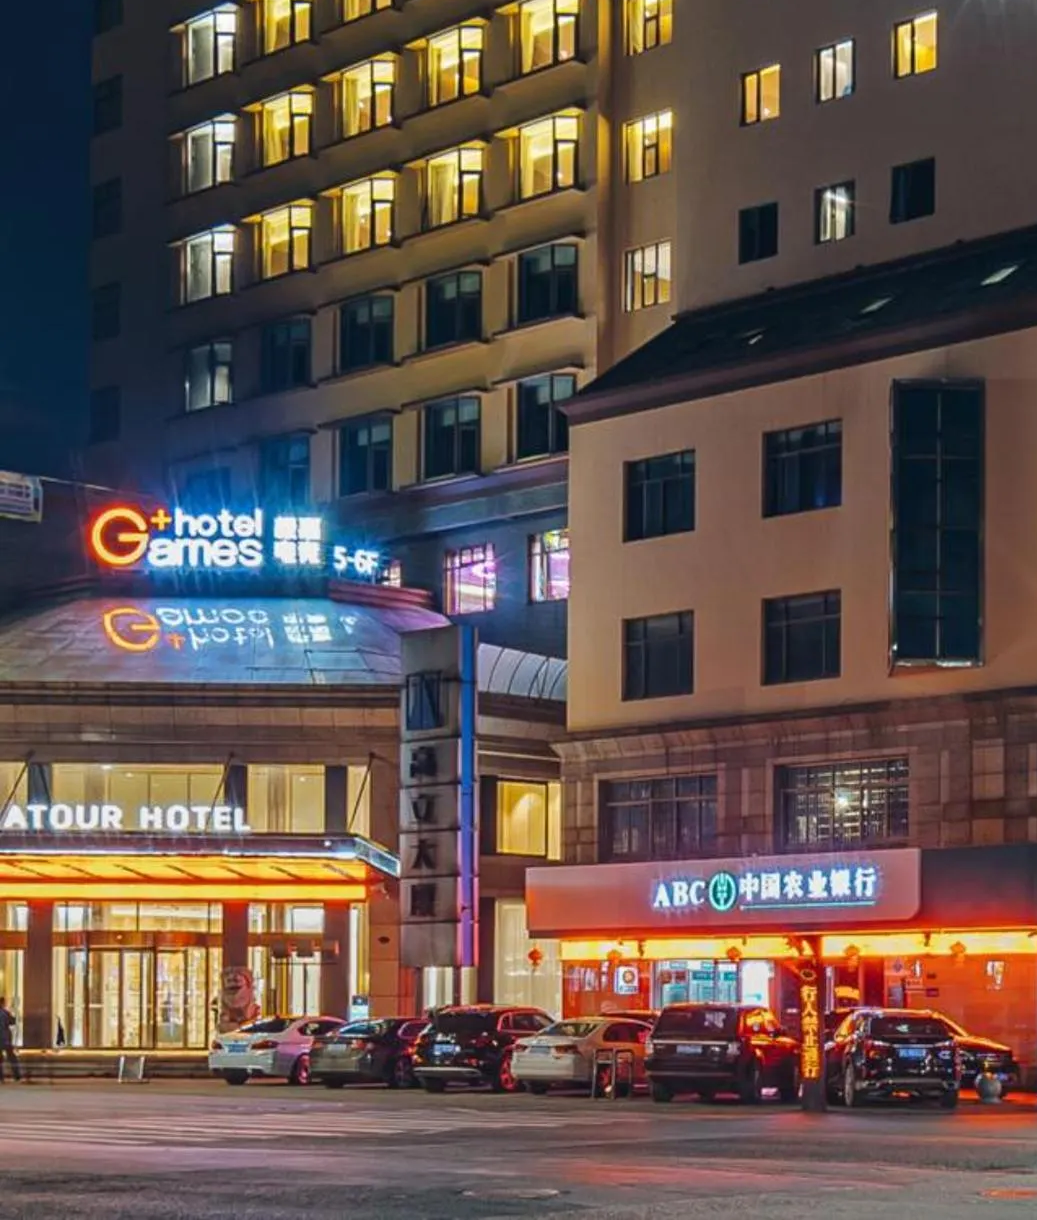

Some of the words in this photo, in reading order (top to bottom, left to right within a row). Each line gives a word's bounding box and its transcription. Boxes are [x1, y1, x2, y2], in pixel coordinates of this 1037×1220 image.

[333, 546, 379, 575] 5-6F
[3, 803, 124, 830] ATOUR
[139, 804, 251, 832] HOTEL
[653, 881, 706, 908] ABC
[738, 867, 877, 901] 中国农业银行
